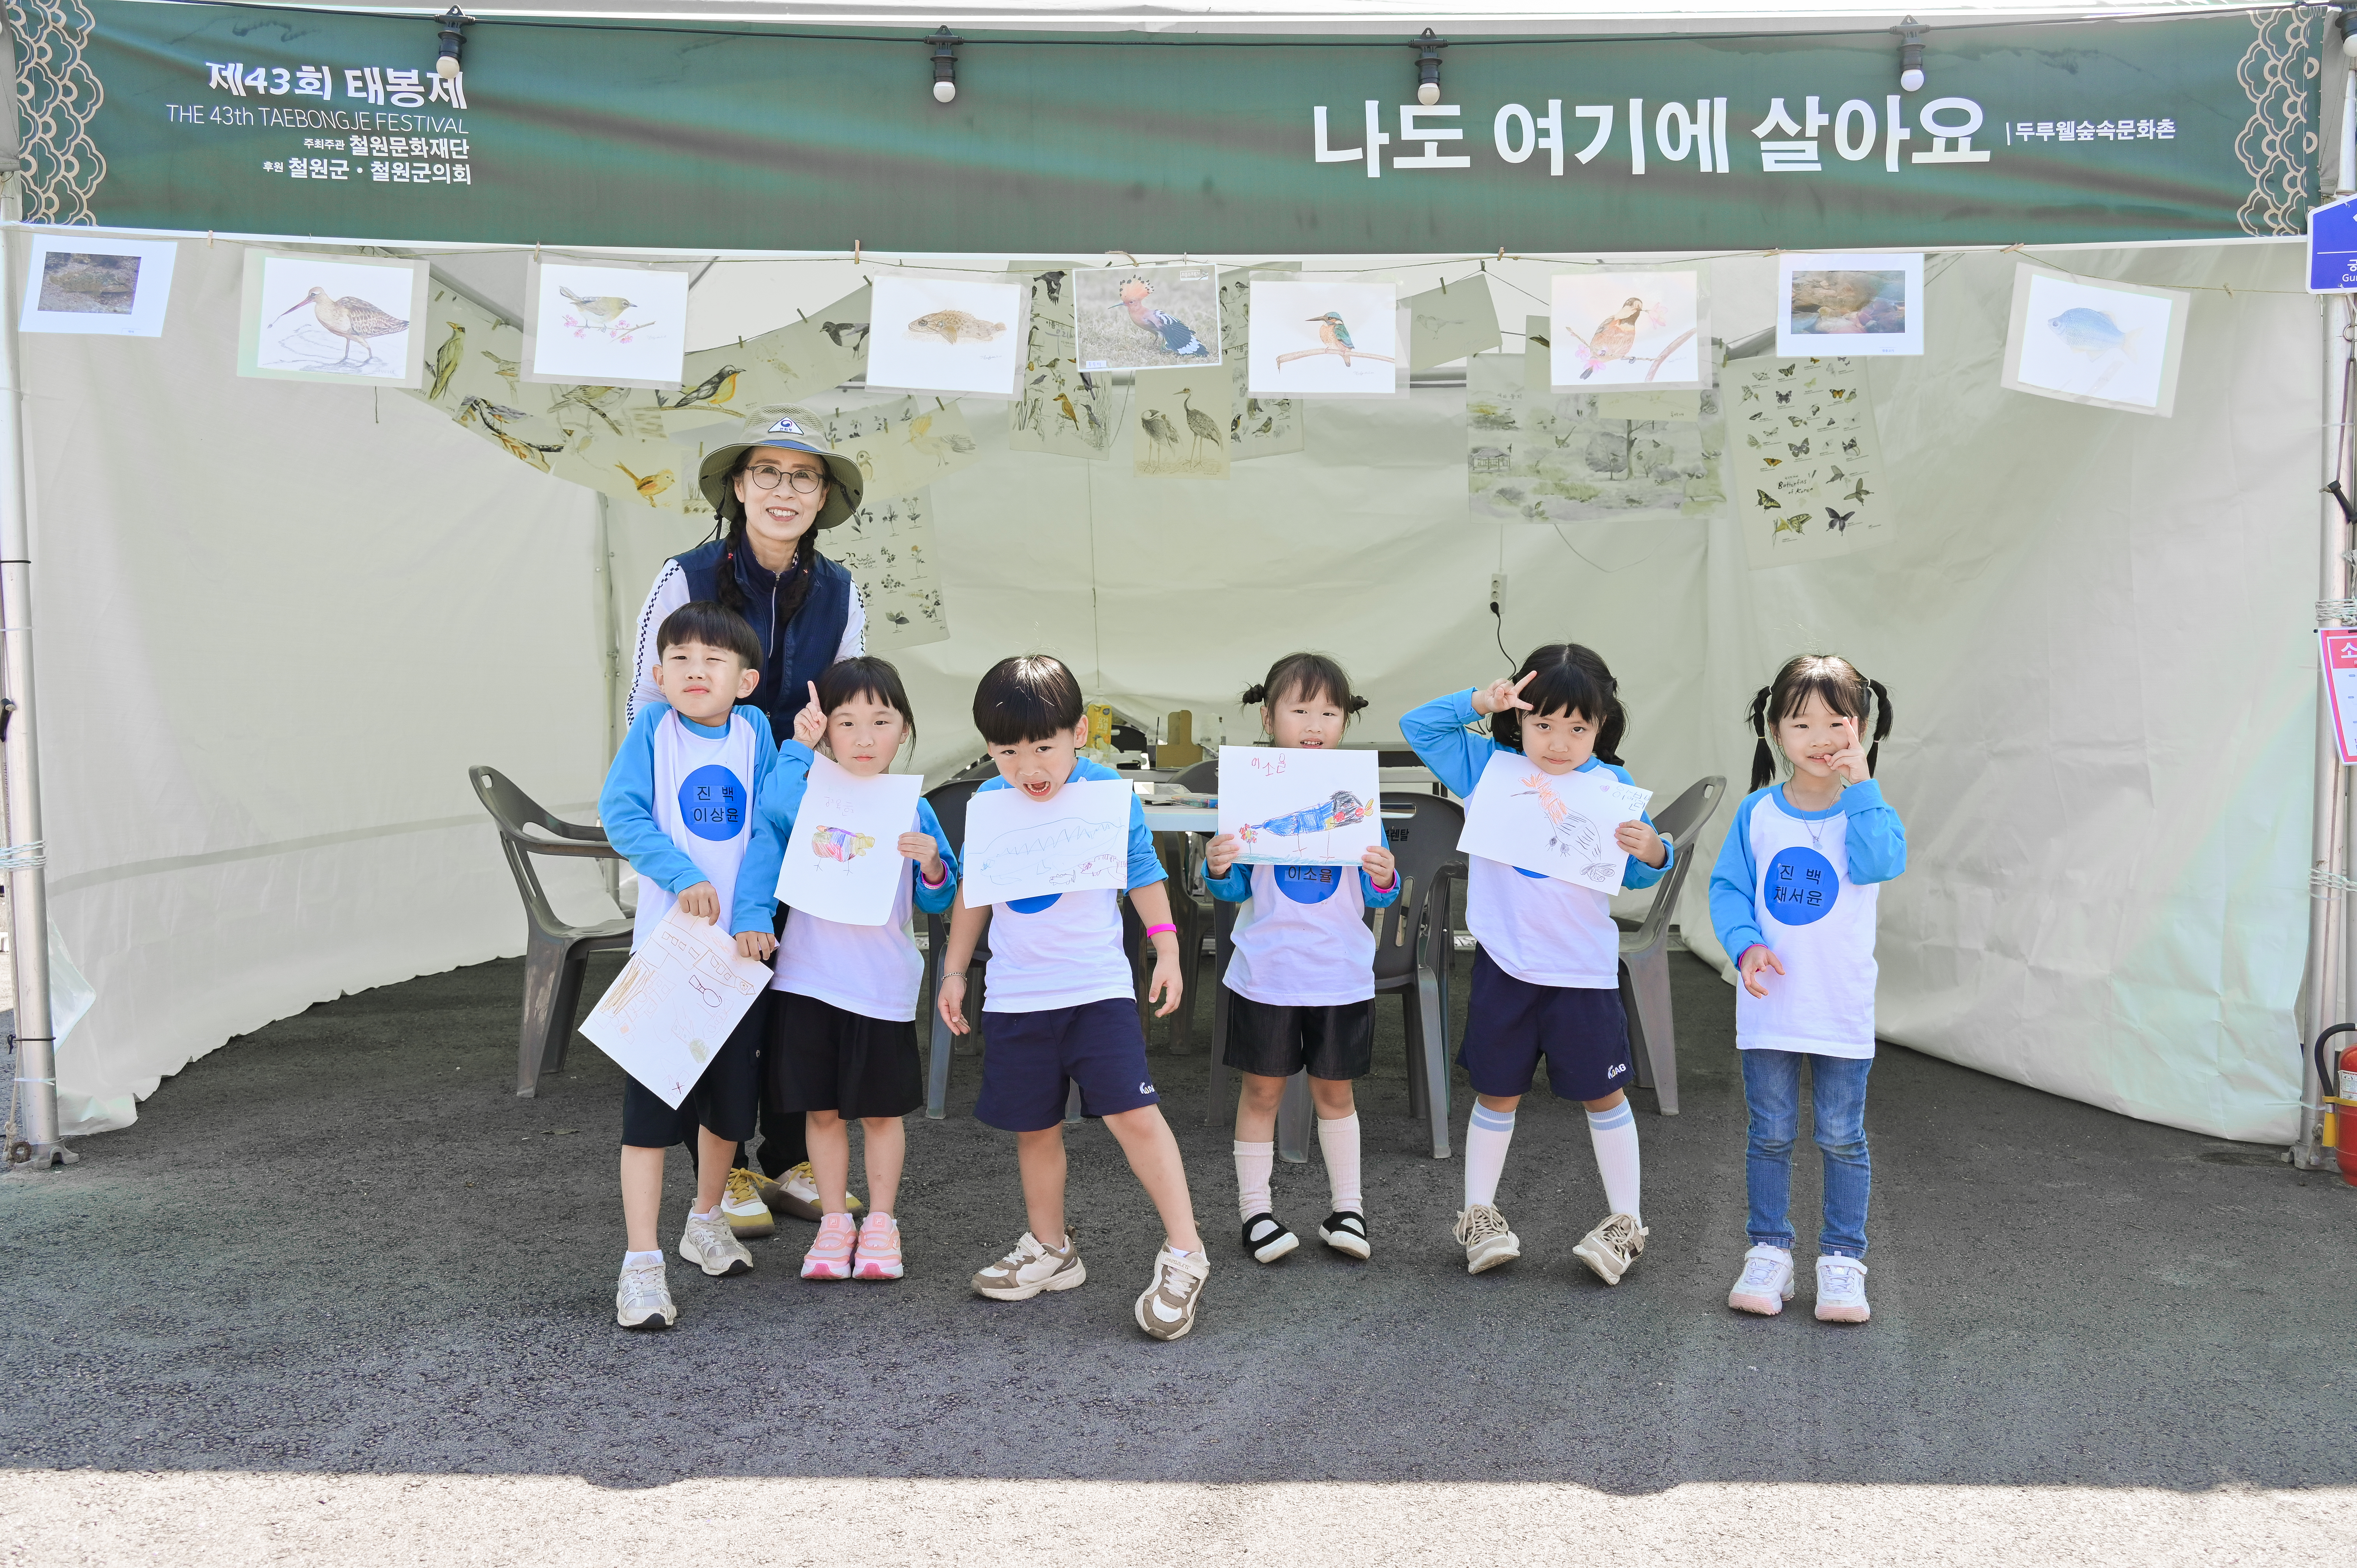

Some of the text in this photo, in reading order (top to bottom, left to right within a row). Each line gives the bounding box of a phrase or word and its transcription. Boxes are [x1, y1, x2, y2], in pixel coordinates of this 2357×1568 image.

[205, 62, 468, 109] 제43회 태봉제
[166, 104, 469, 134] THE 43th TAEBONGJE FESTIVAL
[2016, 119, 2176, 141] 두루웰숲속문화촌
[304, 135, 469, 159] 주최주관 철원문화재단
[1314, 95, 1990, 178] 나도 여기에 살아요
[263, 161, 284, 173] 후원
[288, 157, 350, 180] 철원군
[370, 161, 471, 185] 철원군의회
[697, 786, 734, 802] 진 백
[693, 807, 739, 823] 이상윤
[1288, 866, 1332, 883] 이소율
[1780, 865, 1821, 885] 진 백
[1773, 886, 1822, 906] 채서윤
